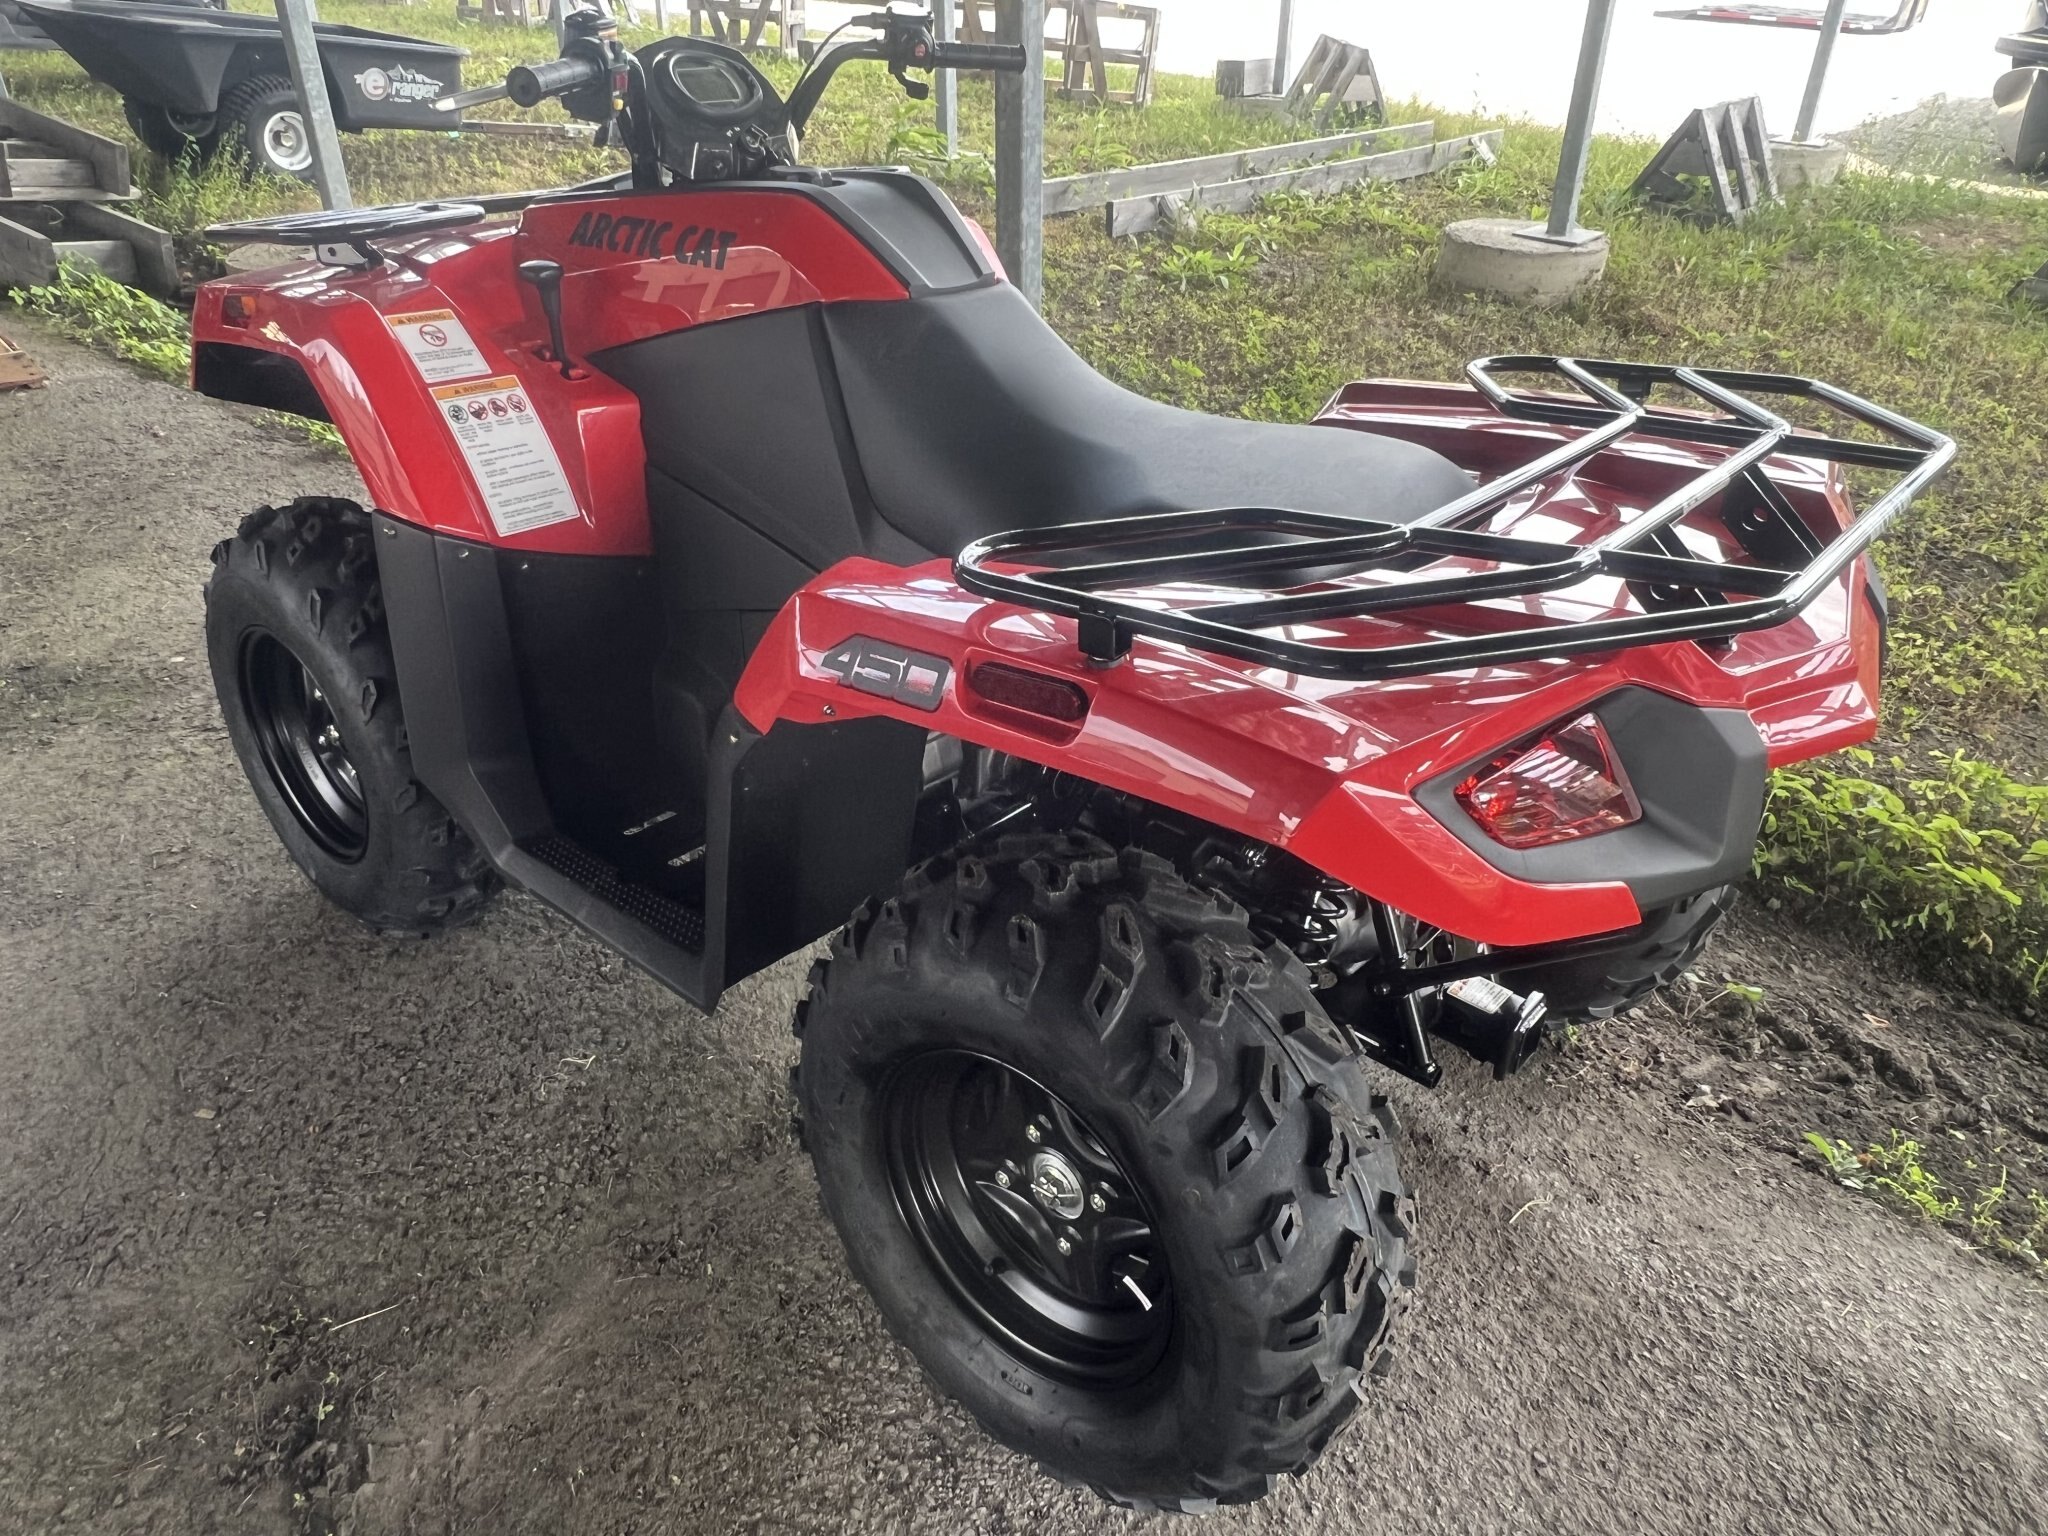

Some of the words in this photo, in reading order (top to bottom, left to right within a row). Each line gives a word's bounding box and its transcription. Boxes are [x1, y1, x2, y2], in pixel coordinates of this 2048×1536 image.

[391, 81, 440, 100] ranger
[568, 212, 673, 260] ARCTIC
[673, 225, 738, 270] CAT
[821, 633, 952, 712] 450
